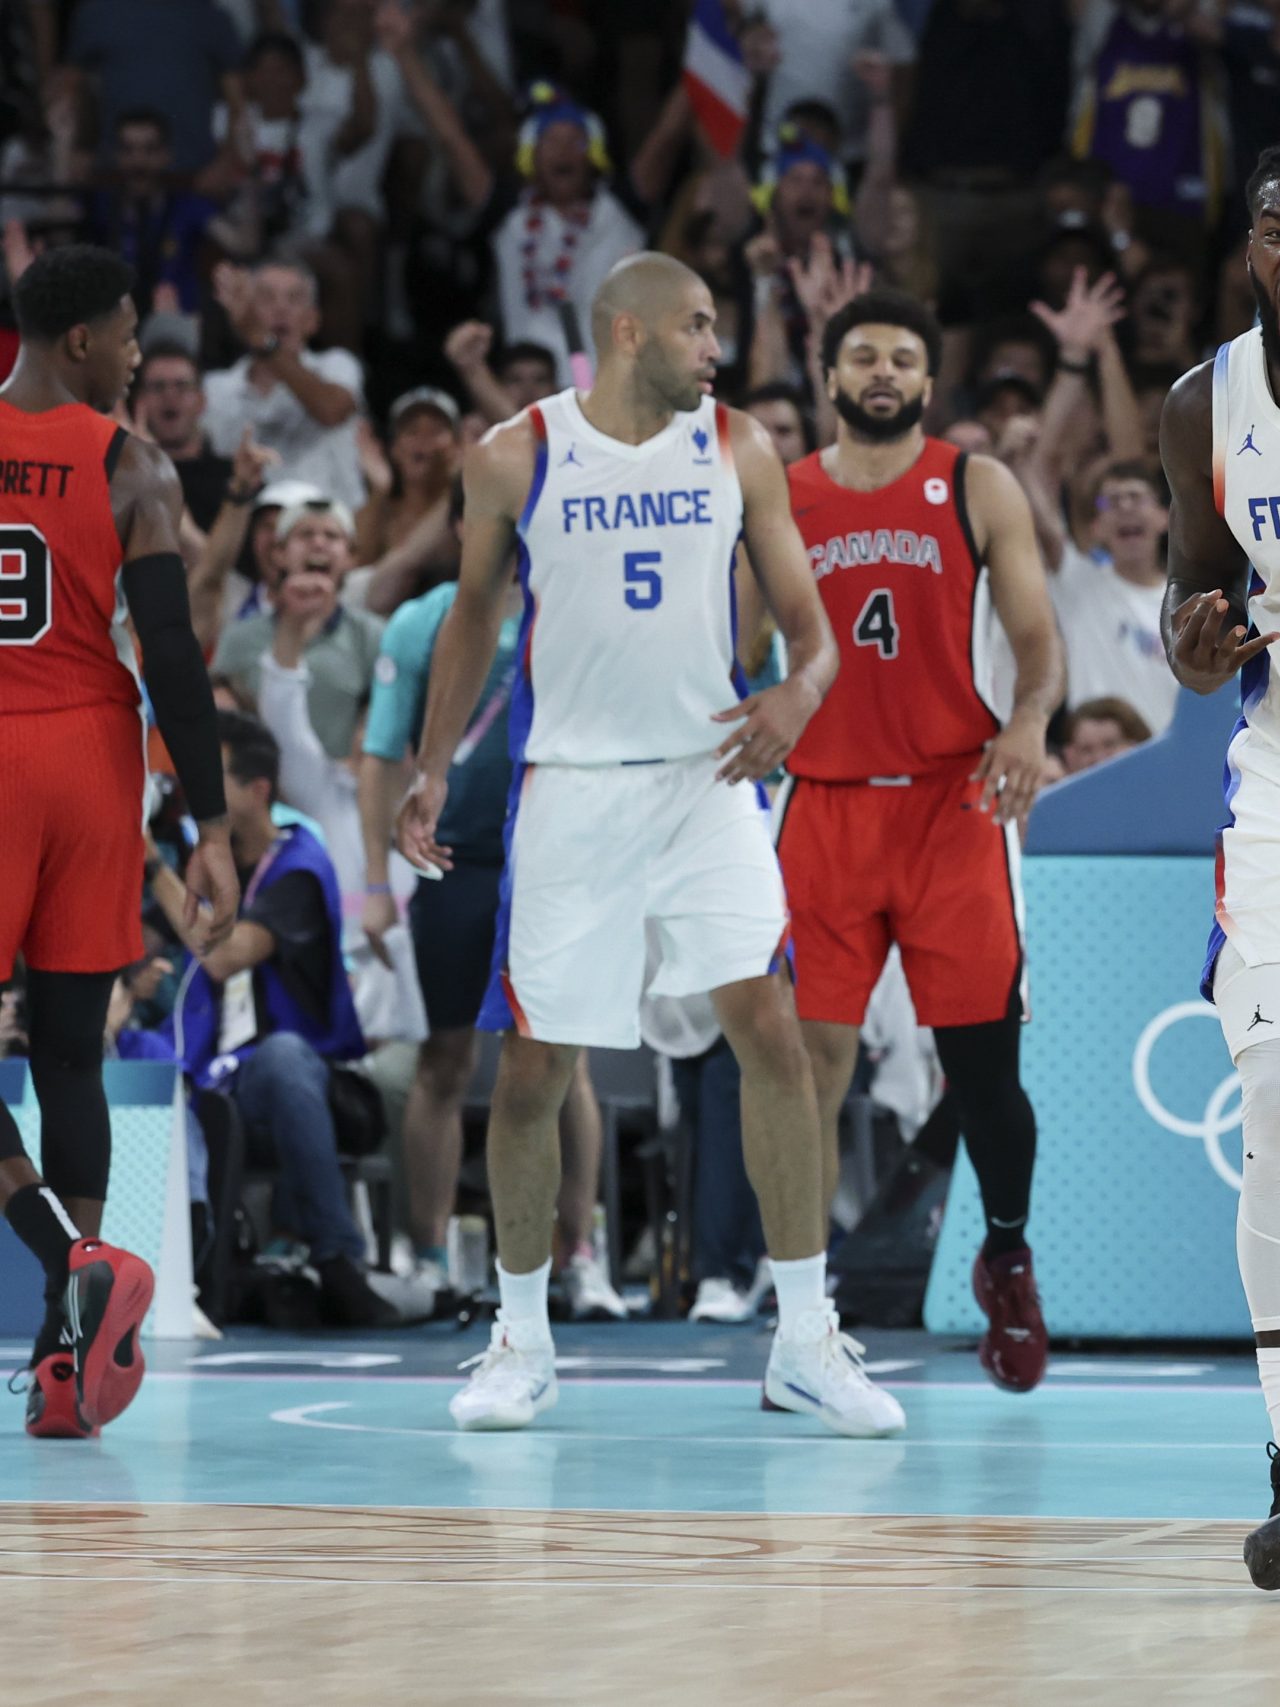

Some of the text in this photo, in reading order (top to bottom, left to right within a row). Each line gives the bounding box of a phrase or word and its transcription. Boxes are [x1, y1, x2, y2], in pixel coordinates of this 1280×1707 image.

[0, 459, 74, 498] RETT
[562, 489, 712, 533] FRANCE
[624, 551, 662, 610] 5
[808, 529, 943, 581] CANADA
[853, 588, 899, 660] 4
